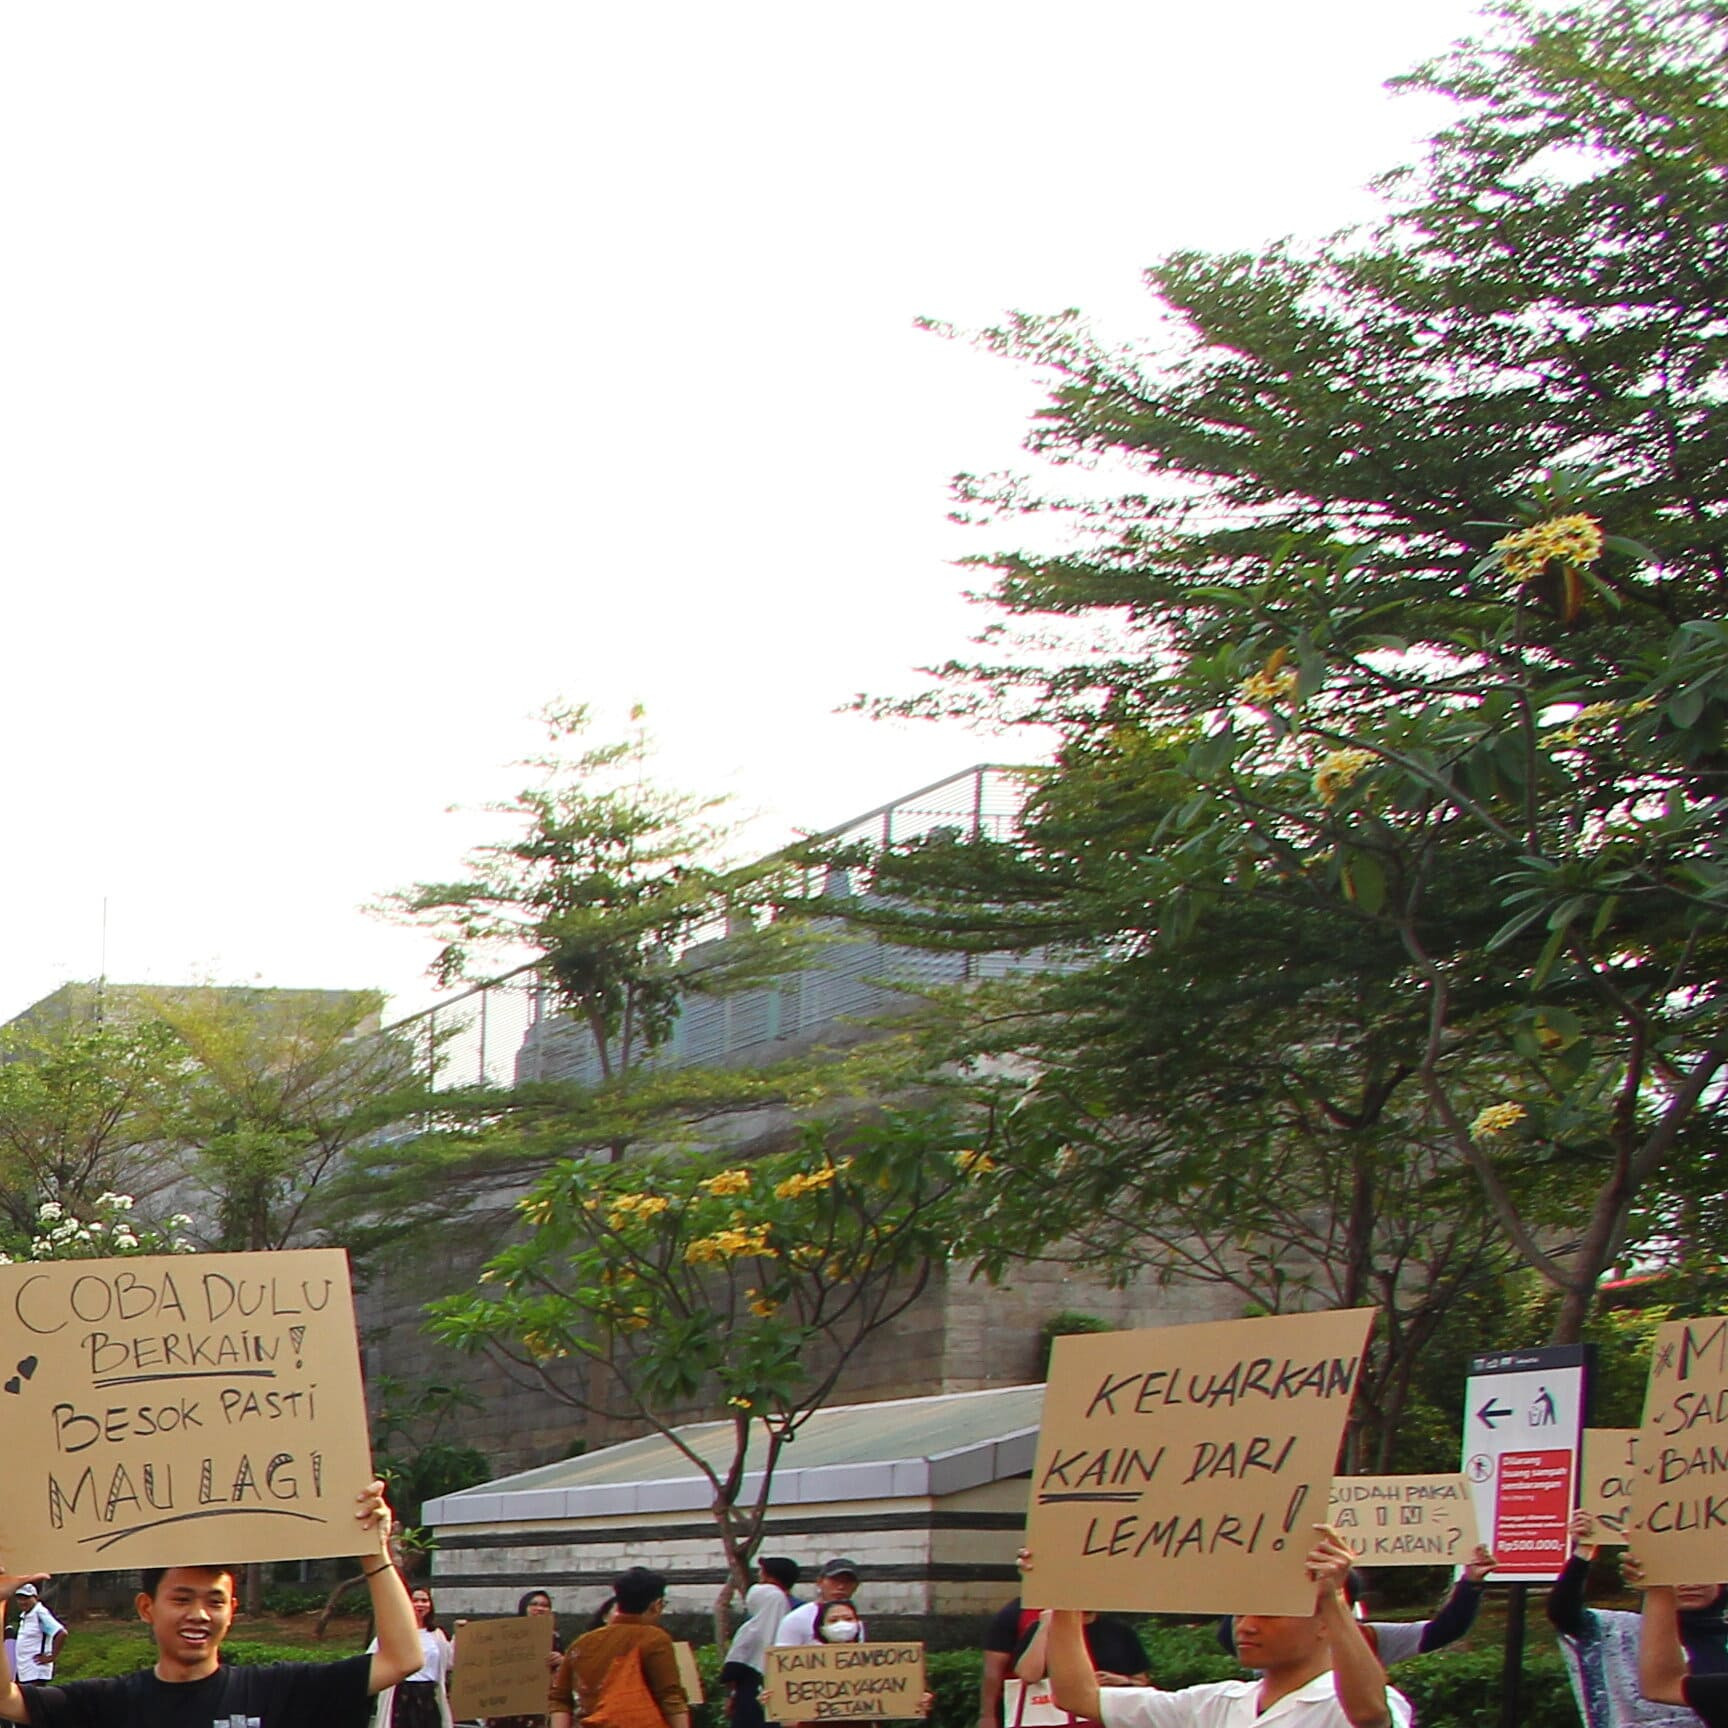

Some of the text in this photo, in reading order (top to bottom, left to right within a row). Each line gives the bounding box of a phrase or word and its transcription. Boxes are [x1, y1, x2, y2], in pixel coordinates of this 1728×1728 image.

[15, 1271, 333, 1334] COBA DULU
[1084, 1356, 1358, 1418] KELUARKAN
[51, 1402, 204, 1453] BESOK
[1040, 1435, 1297, 1489] KAIN DARI
[48, 1463, 173, 1529] MAU
[1080, 1484, 1309, 1559] LEMARI!
[1334, 1505, 1423, 1529] AIN
[775, 1651, 827, 1673] KAIN
[785, 1676, 908, 1704] BERDAYAKAN
